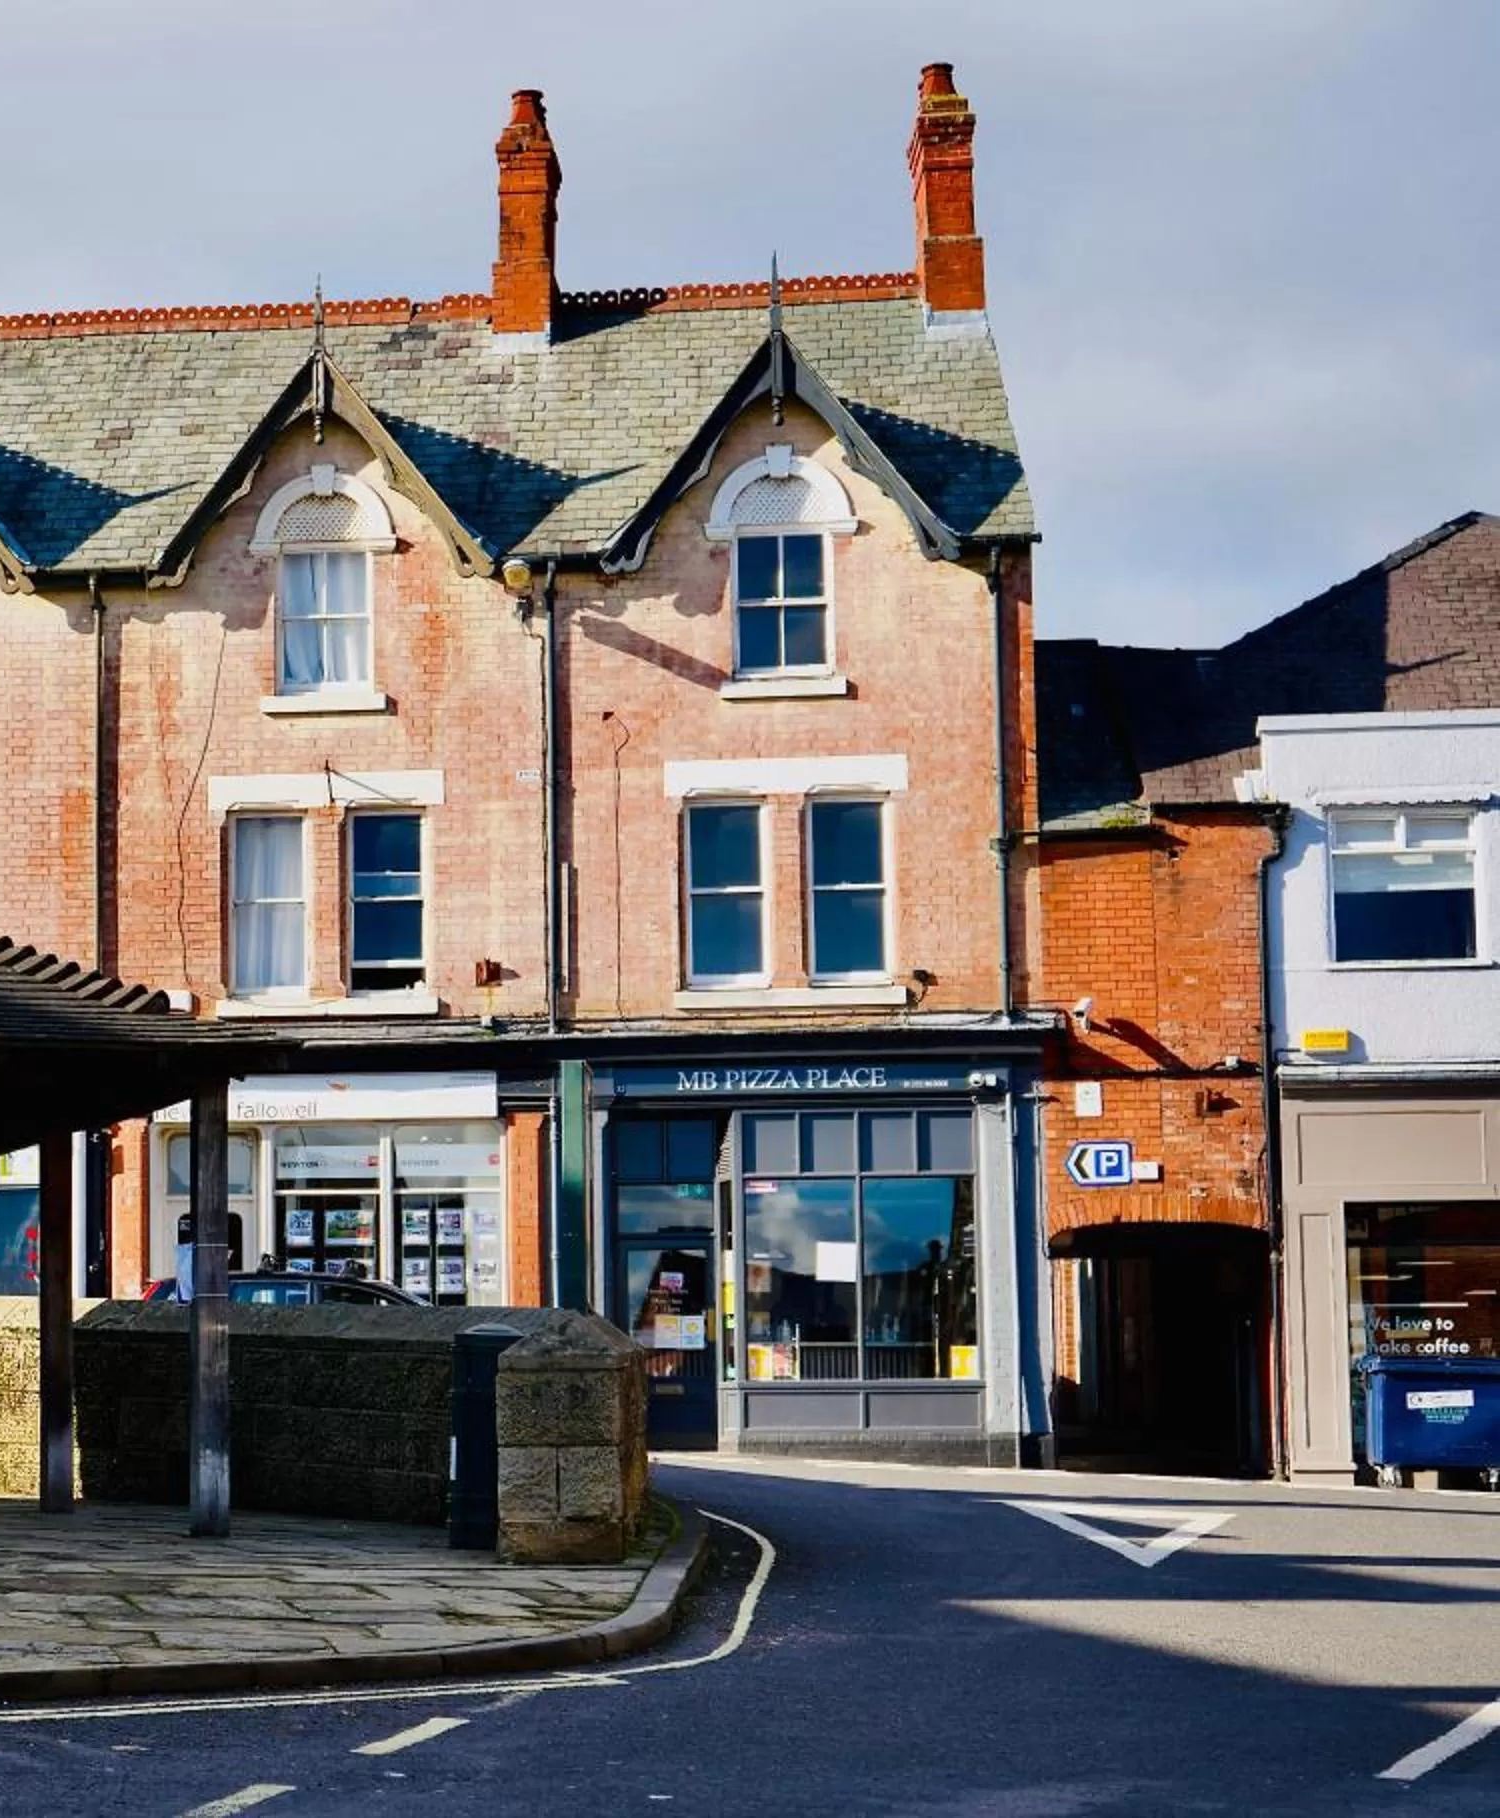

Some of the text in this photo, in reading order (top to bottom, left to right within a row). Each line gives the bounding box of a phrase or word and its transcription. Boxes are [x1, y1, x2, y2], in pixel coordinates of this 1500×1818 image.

[677, 1071, 717, 1091] MB
[724, 1069, 800, 1090] PIZZA
[807, 1067, 887, 1089] PLACE
[236, 1101, 318, 1119] fallowell
[1100, 1151, 1119, 1175] P
[1395, 1315, 1432, 1331] love
[1436, 1317, 1455, 1331] to
[1415, 1337, 1471, 1354] coffee
